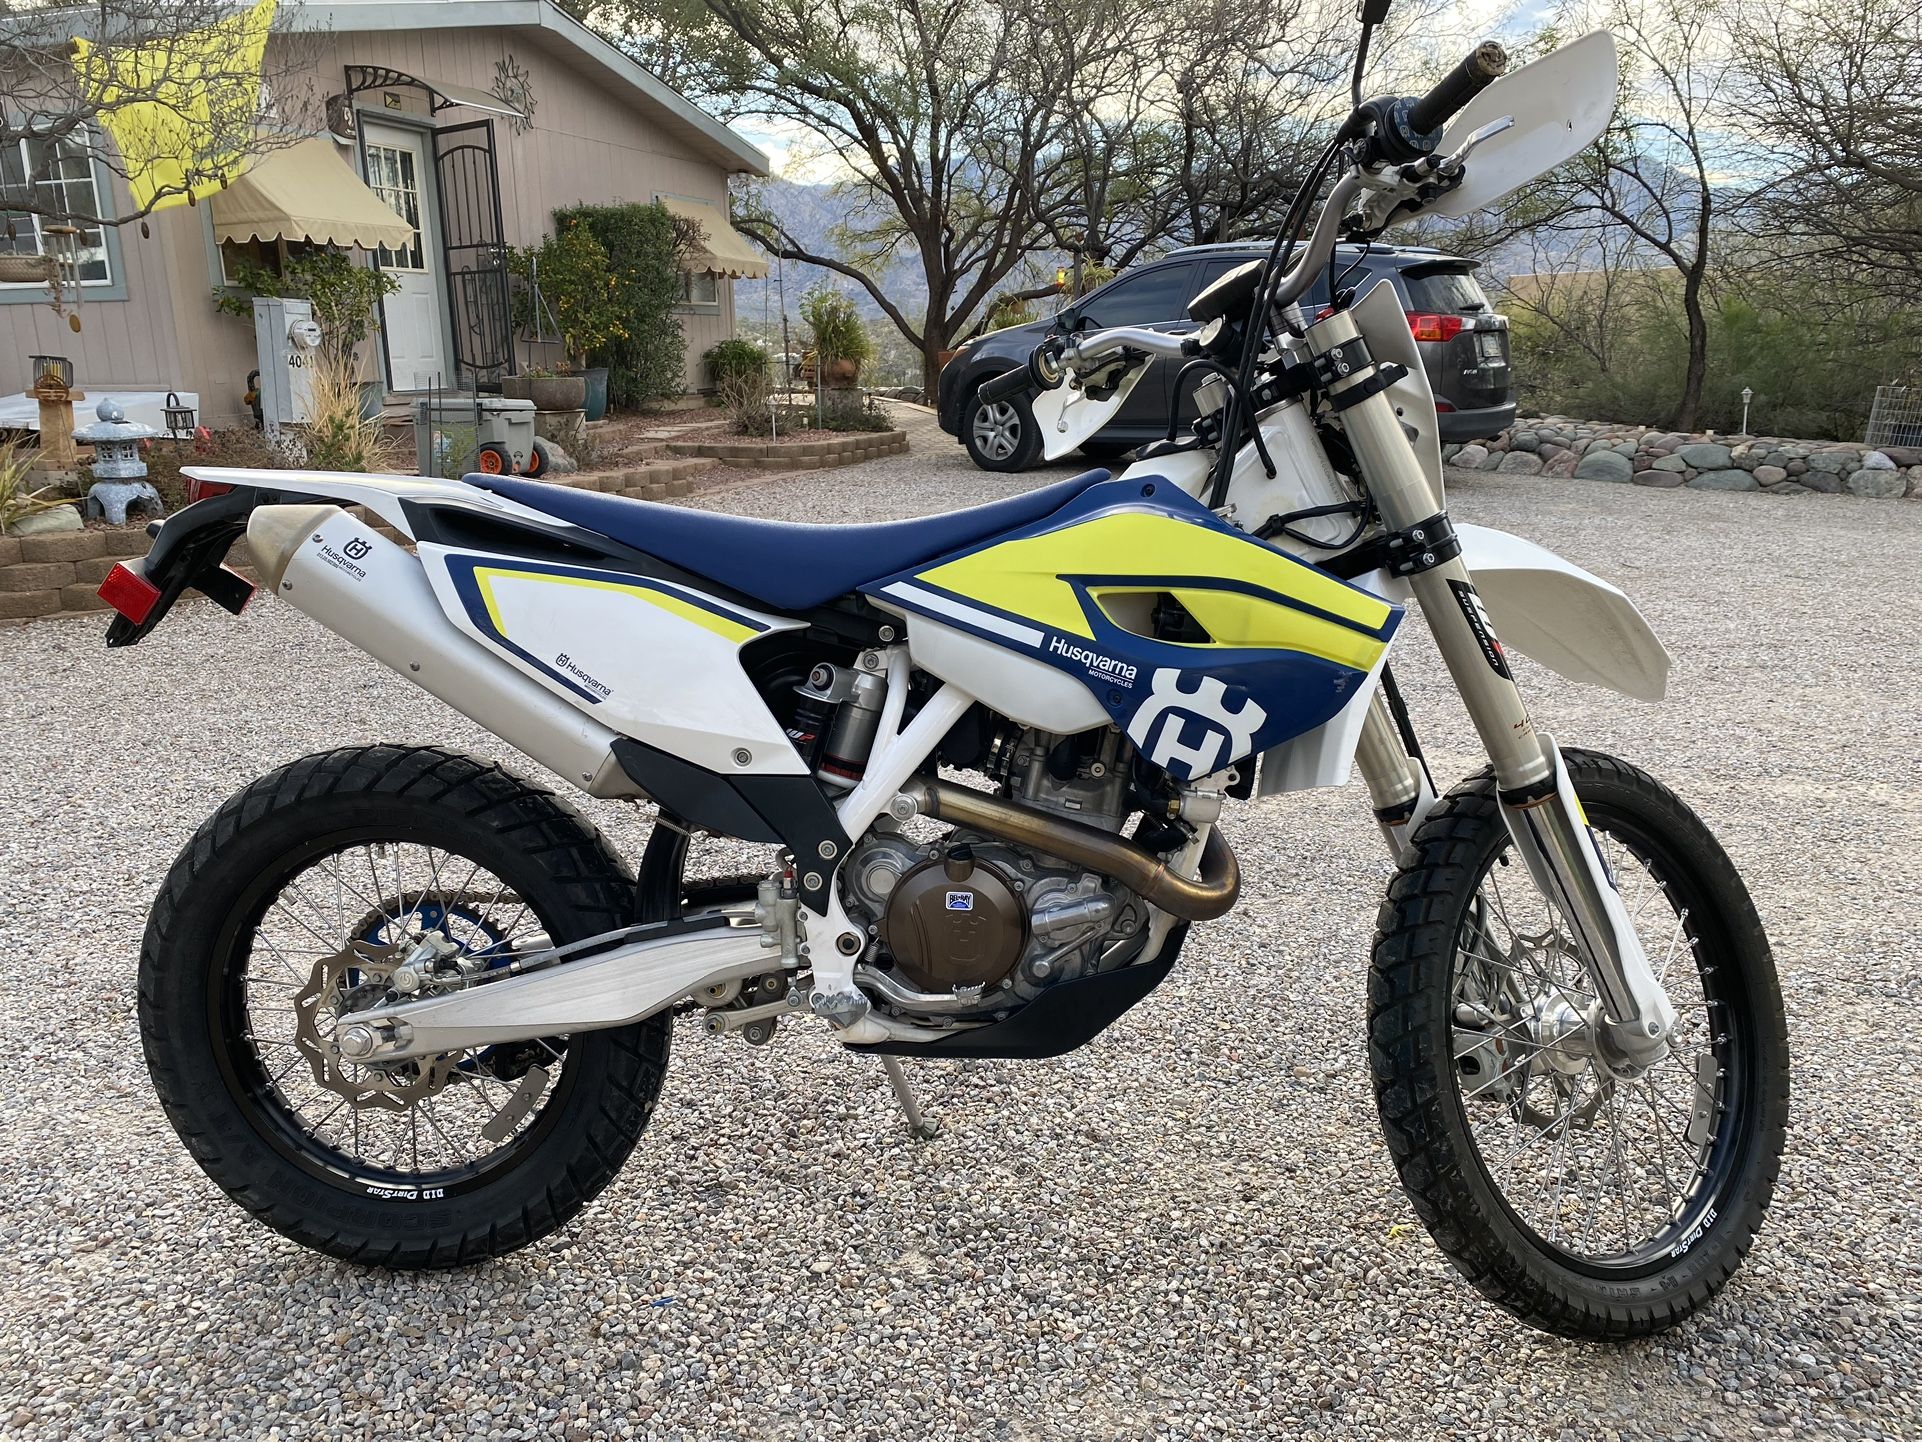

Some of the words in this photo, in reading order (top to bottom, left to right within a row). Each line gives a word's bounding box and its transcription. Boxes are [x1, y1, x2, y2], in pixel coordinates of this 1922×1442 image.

[321, 545, 367, 578] Husqvarna
[1049, 636, 1138, 680] Husqvarna
[566, 661, 612, 696] Husqvarna
[1088, 669, 1133, 689] MOTORCYCLES
